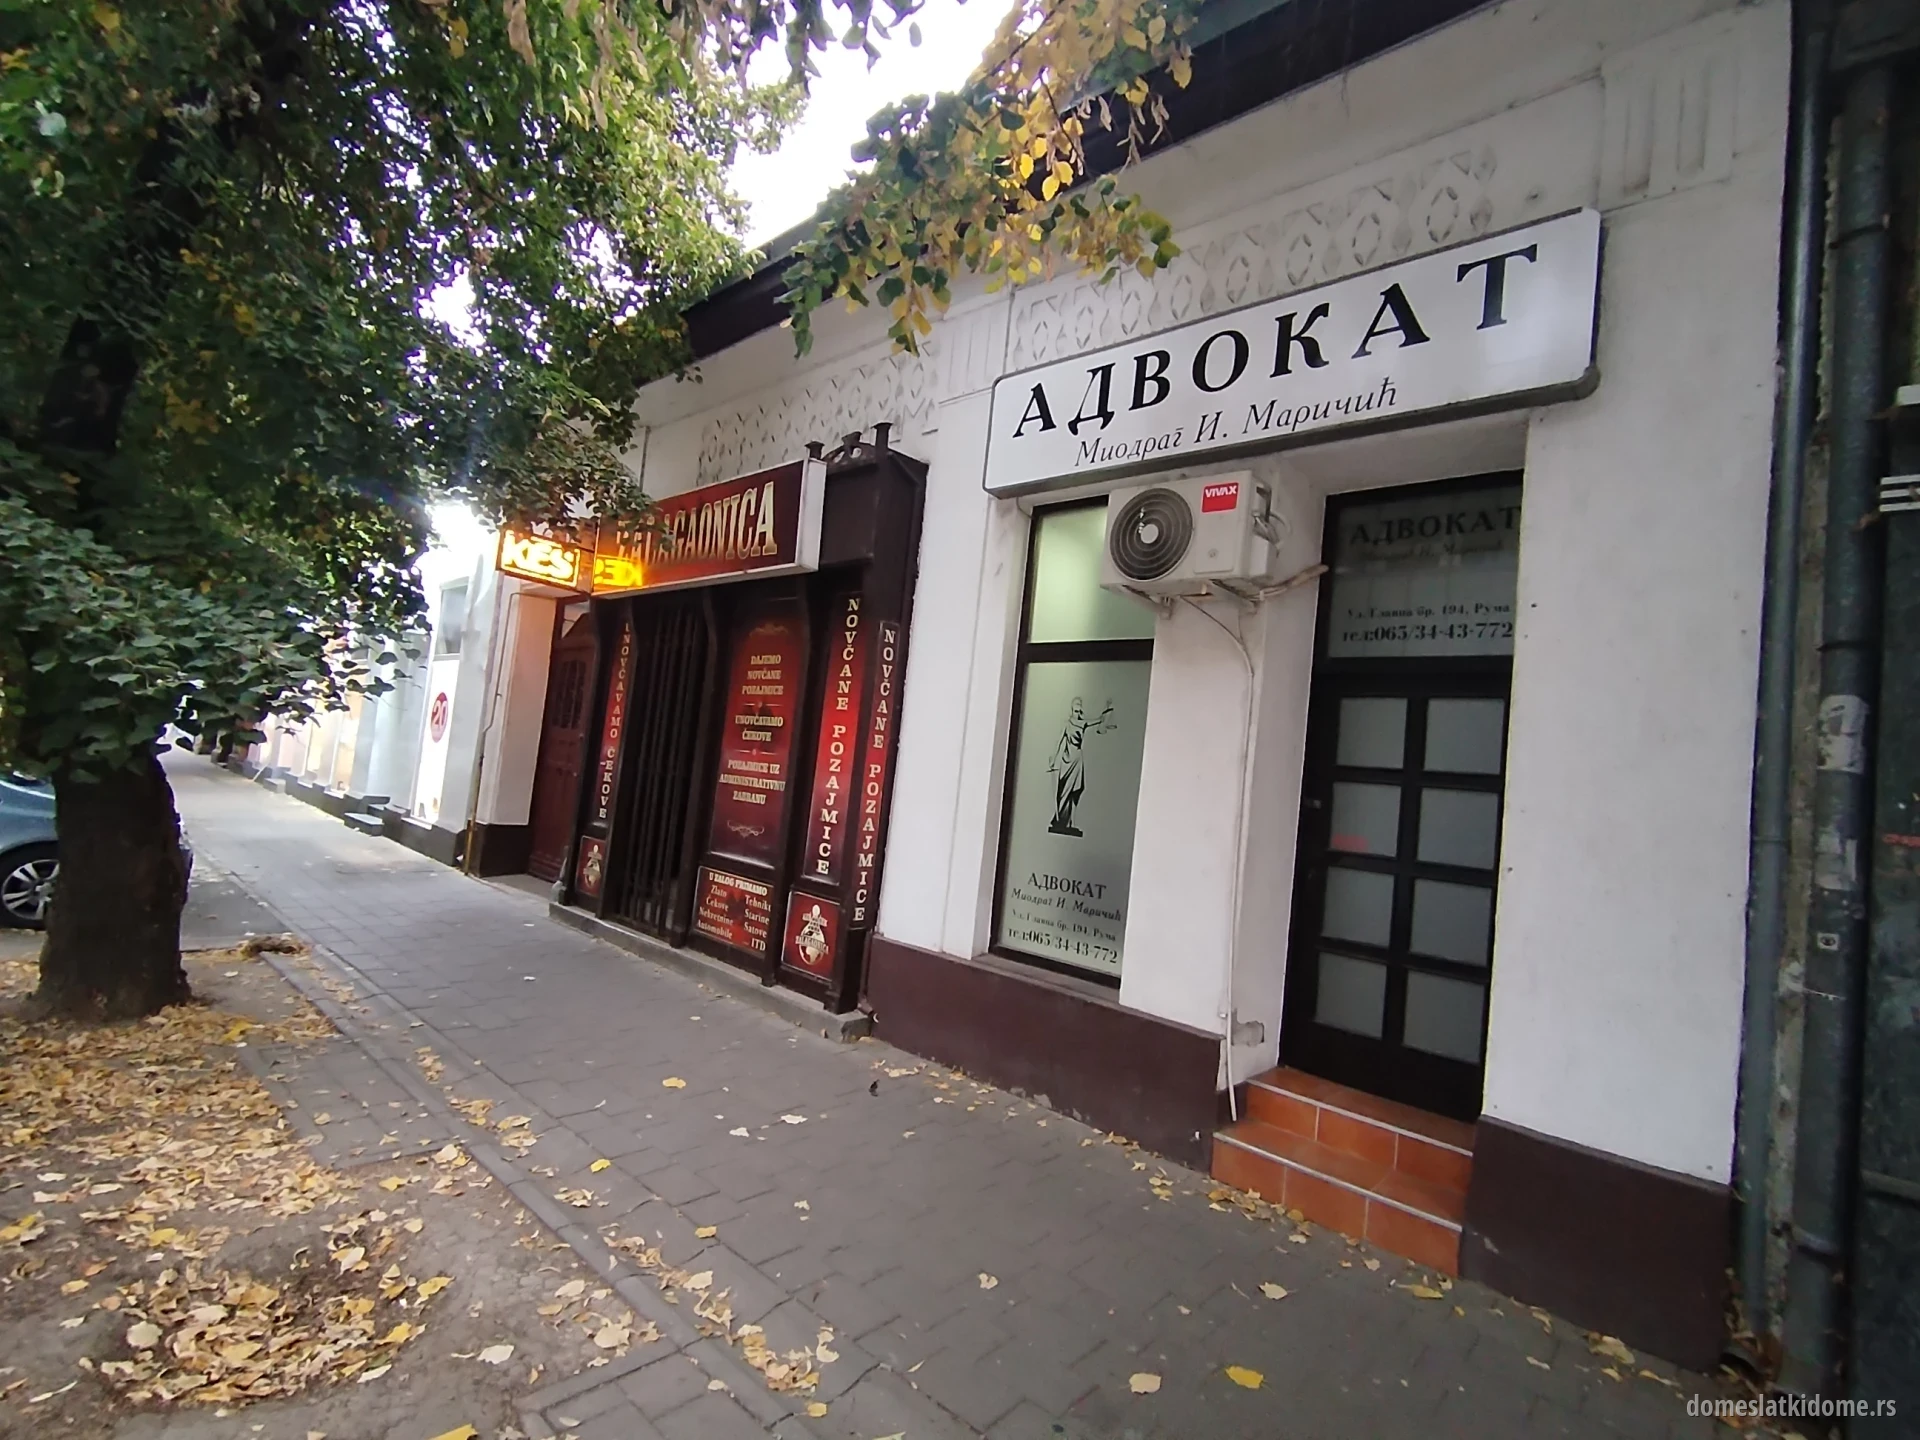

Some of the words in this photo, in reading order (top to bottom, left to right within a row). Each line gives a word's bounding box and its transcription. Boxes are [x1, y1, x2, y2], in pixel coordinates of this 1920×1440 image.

[1013, 243, 1537, 437] АДВОКАТ
[1075, 426, 1182, 466] Миодраг
[1194, 411, 1228, 443] И.
[1242, 376, 1396, 433] Маричић
[1204, 484, 1237, 498] VIVAX
[1351, 505, 1521, 545] АДВОКАТ
[836, 597, 860, 711] NOVČANE
[815, 724, 847, 875] POZAJMICE
[853, 764, 882, 922] POZAJMICE
[1027, 872, 1107, 900] АДВОКАТ
